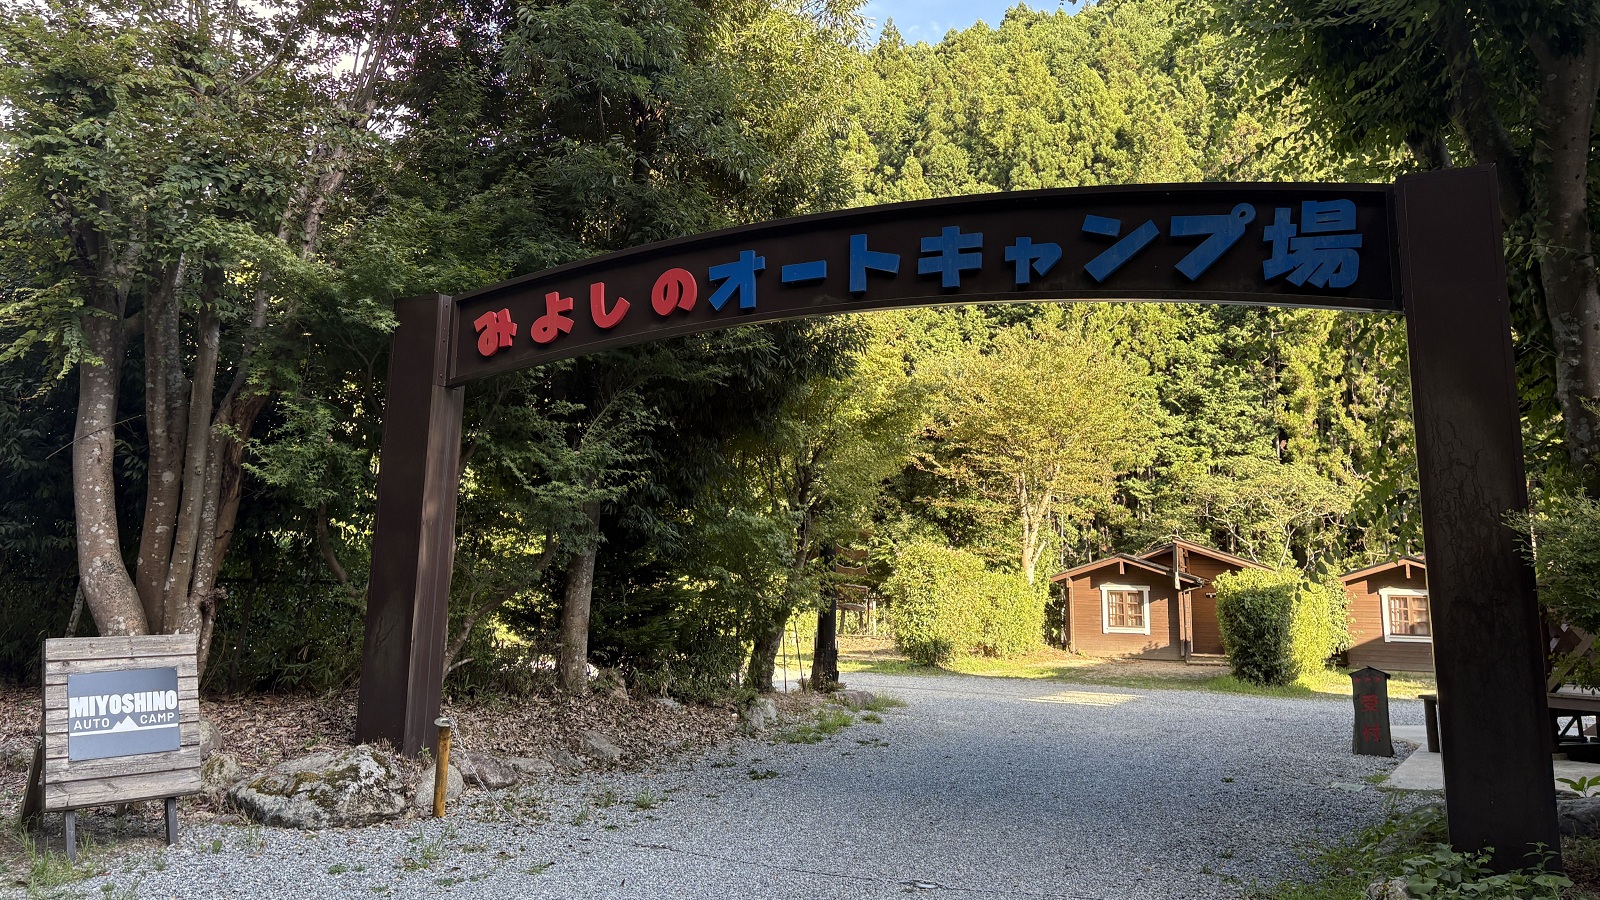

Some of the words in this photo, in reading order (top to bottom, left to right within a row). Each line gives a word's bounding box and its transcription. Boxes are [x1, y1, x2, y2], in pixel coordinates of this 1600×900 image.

[474, 198, 1363, 357] みよしのオートキャンプ場
[69, 690, 178, 719] MIYOSHINO
[73, 717, 110, 731] AUTO
[140, 712, 175, 725] CAMP
[1360, 694, 1381, 742] 受付
